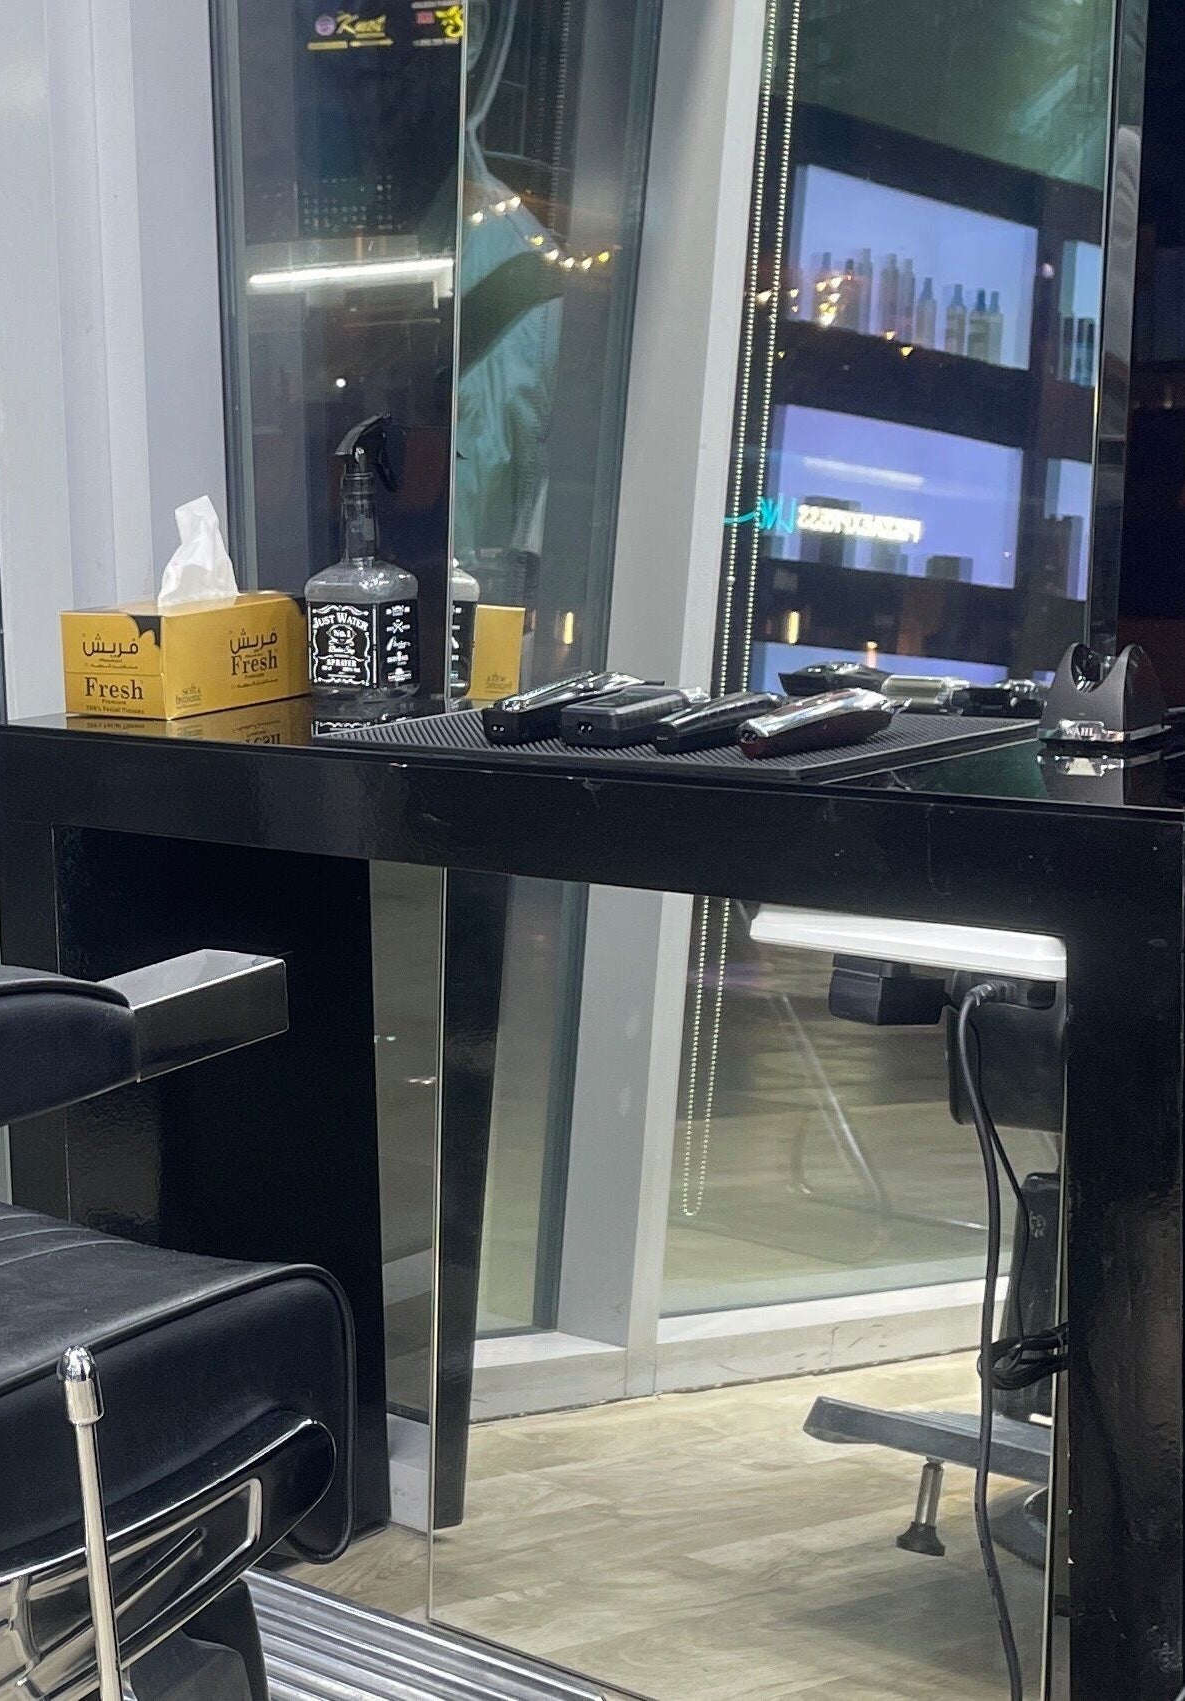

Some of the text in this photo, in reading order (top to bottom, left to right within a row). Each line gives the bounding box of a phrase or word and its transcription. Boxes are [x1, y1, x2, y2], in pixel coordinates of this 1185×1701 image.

[312, 615, 335, 628] JUST
[336, 612, 368, 631] WATER
[82, 633, 139, 658] فريش
[230, 628, 278, 654] فريش
[231, 650, 278, 676] Fresh
[84, 677, 144, 700] Fresh
[1066, 727, 1093, 736] WAHL
